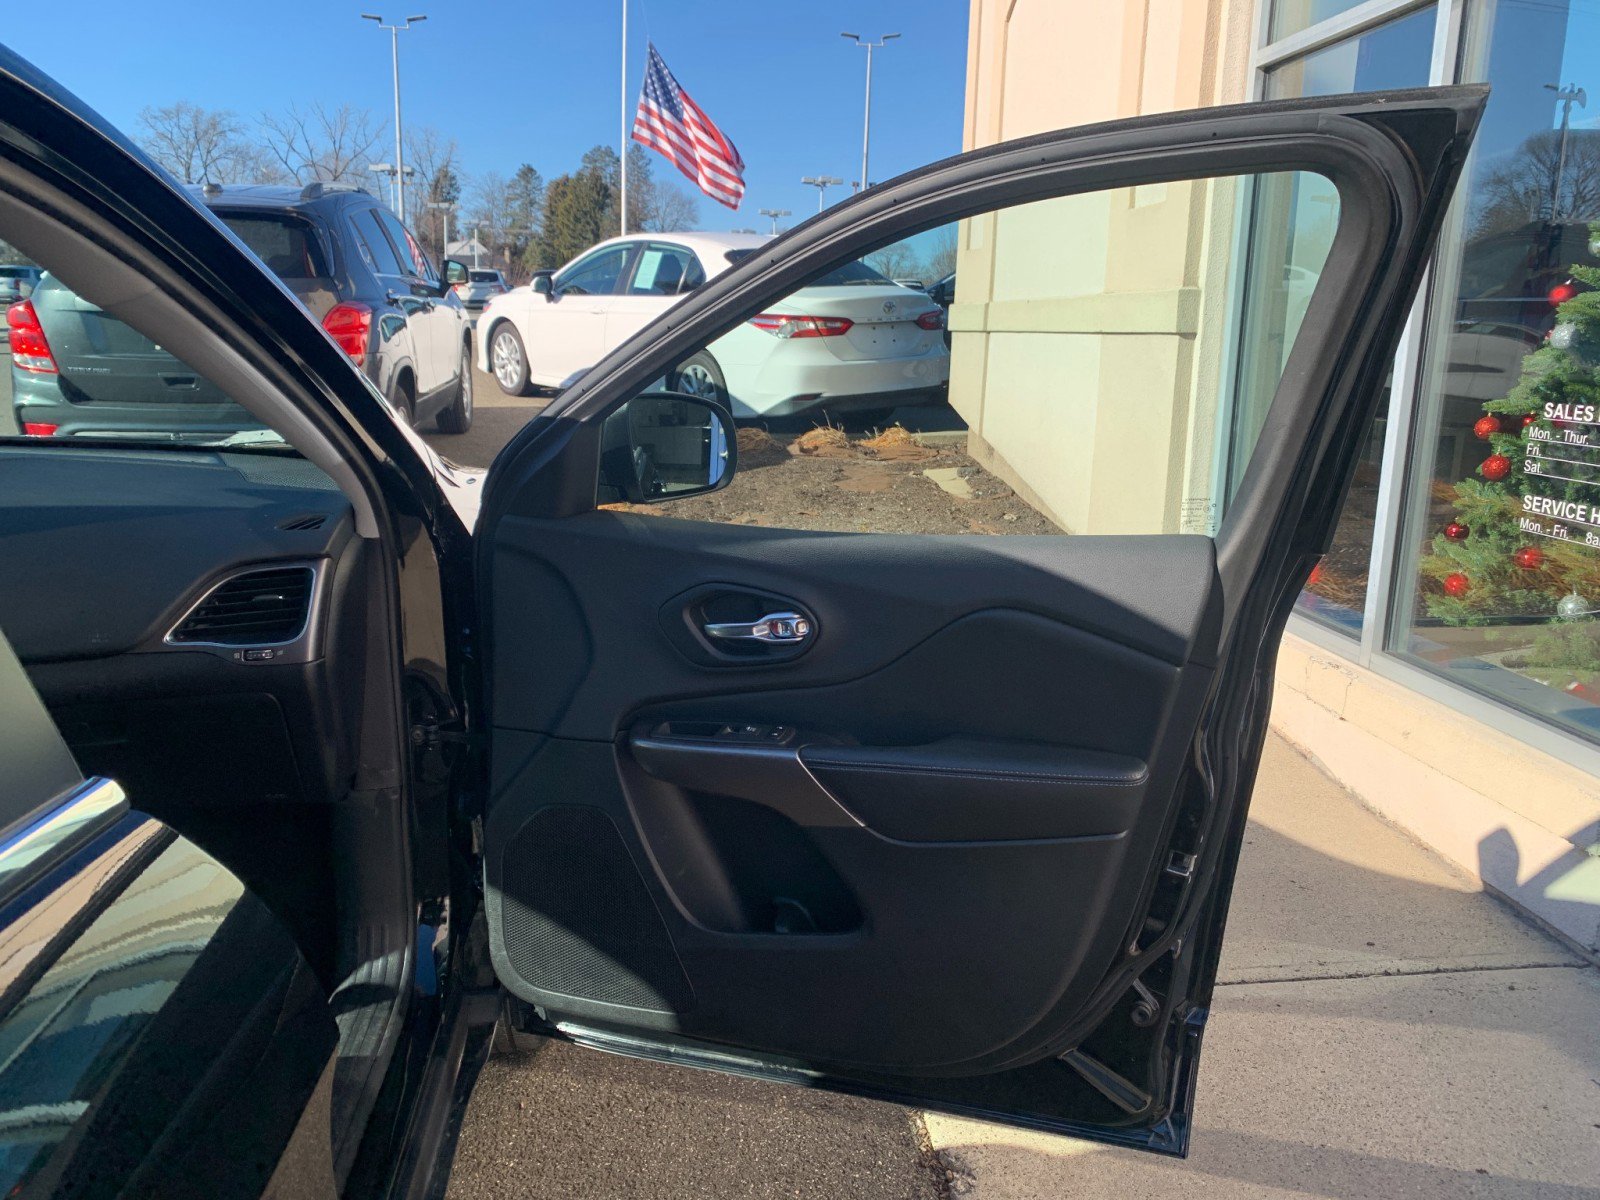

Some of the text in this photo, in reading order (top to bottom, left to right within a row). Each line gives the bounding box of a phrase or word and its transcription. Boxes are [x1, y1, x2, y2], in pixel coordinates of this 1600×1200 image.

[1544, 402, 1594, 422] SALES
[1529, 427, 1553, 440] Mon.
[1564, 430, 1589, 445] Thur.
[1526, 443, 1542, 456] Fri.
[1524, 460, 1543, 474] Sat.
[1523, 495, 1586, 521] SERVICE
[1520, 517, 1543, 533] Mon.
[1553, 525, 1569, 540] Fri.
[1586, 531, 1600, 546] 8a
